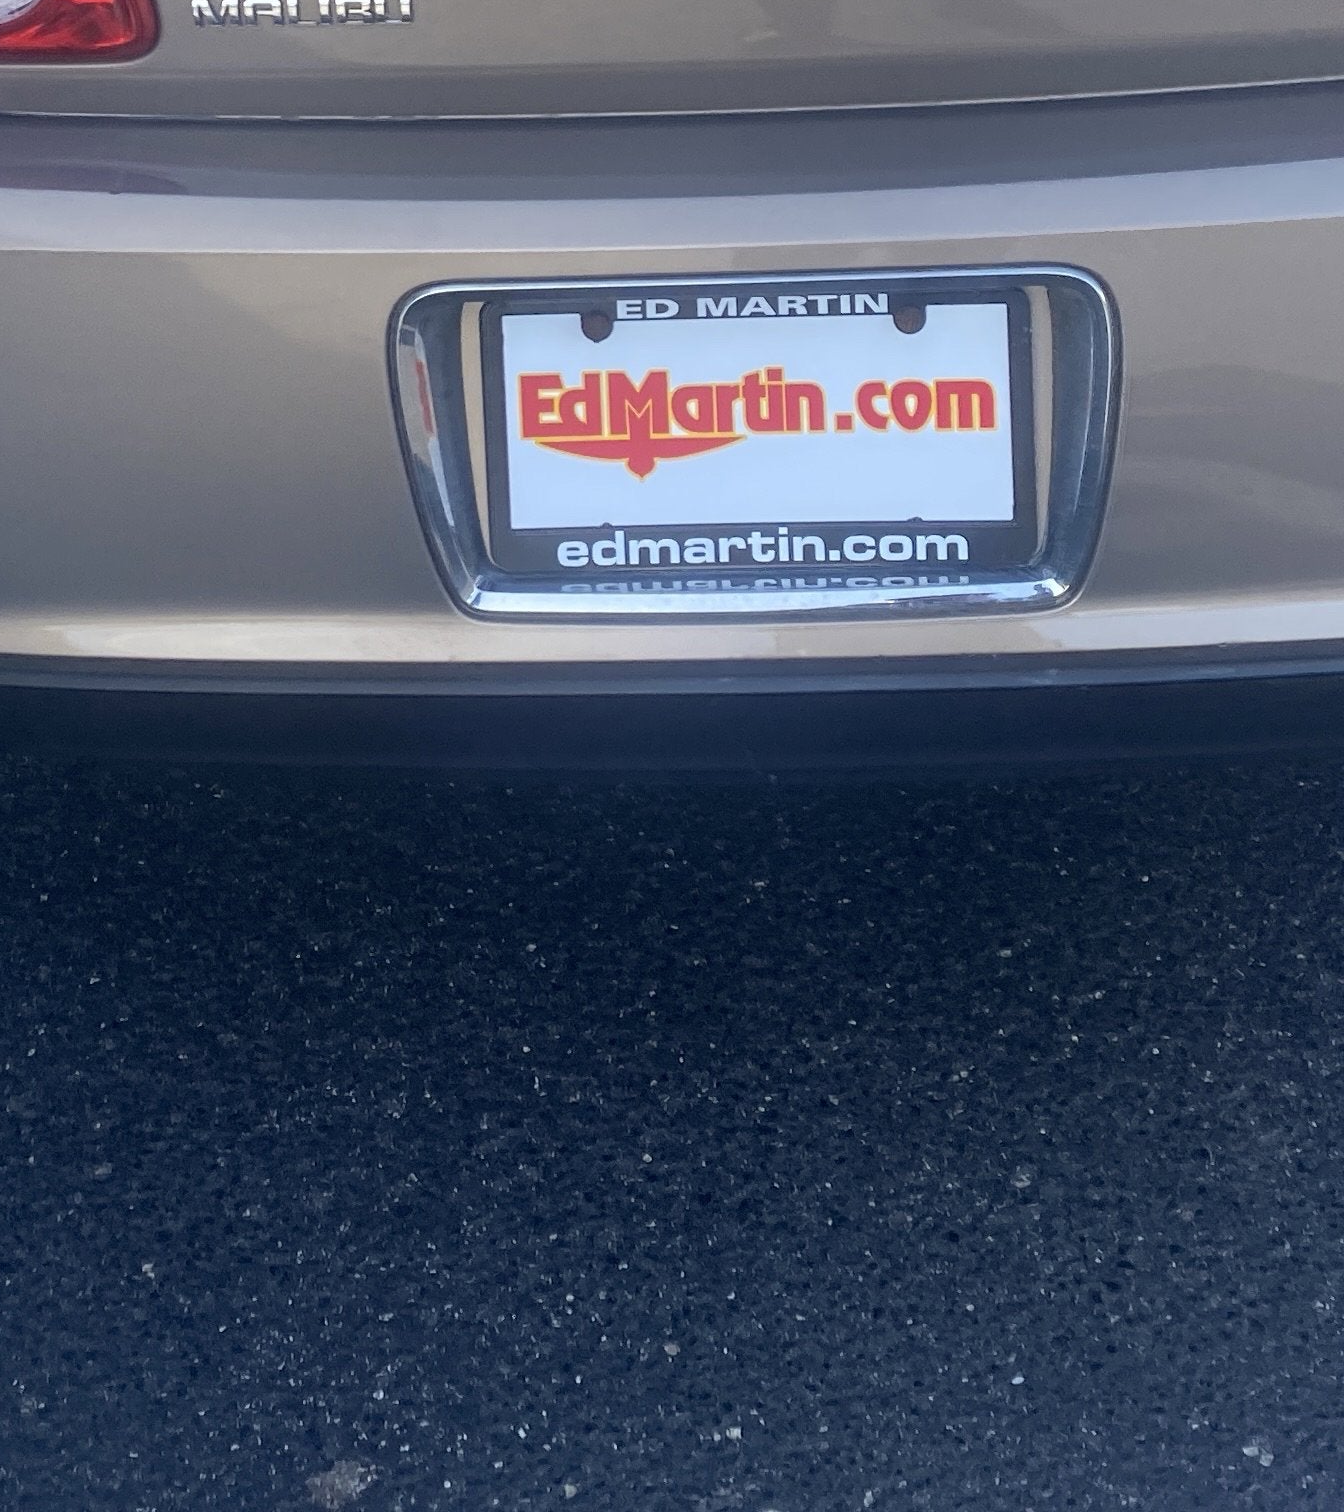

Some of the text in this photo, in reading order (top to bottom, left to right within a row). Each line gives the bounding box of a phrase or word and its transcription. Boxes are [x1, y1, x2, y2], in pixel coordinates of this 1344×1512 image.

[616, 293, 889, 321] ED MARTIN
[556, 526, 970, 568] edmartin.com
